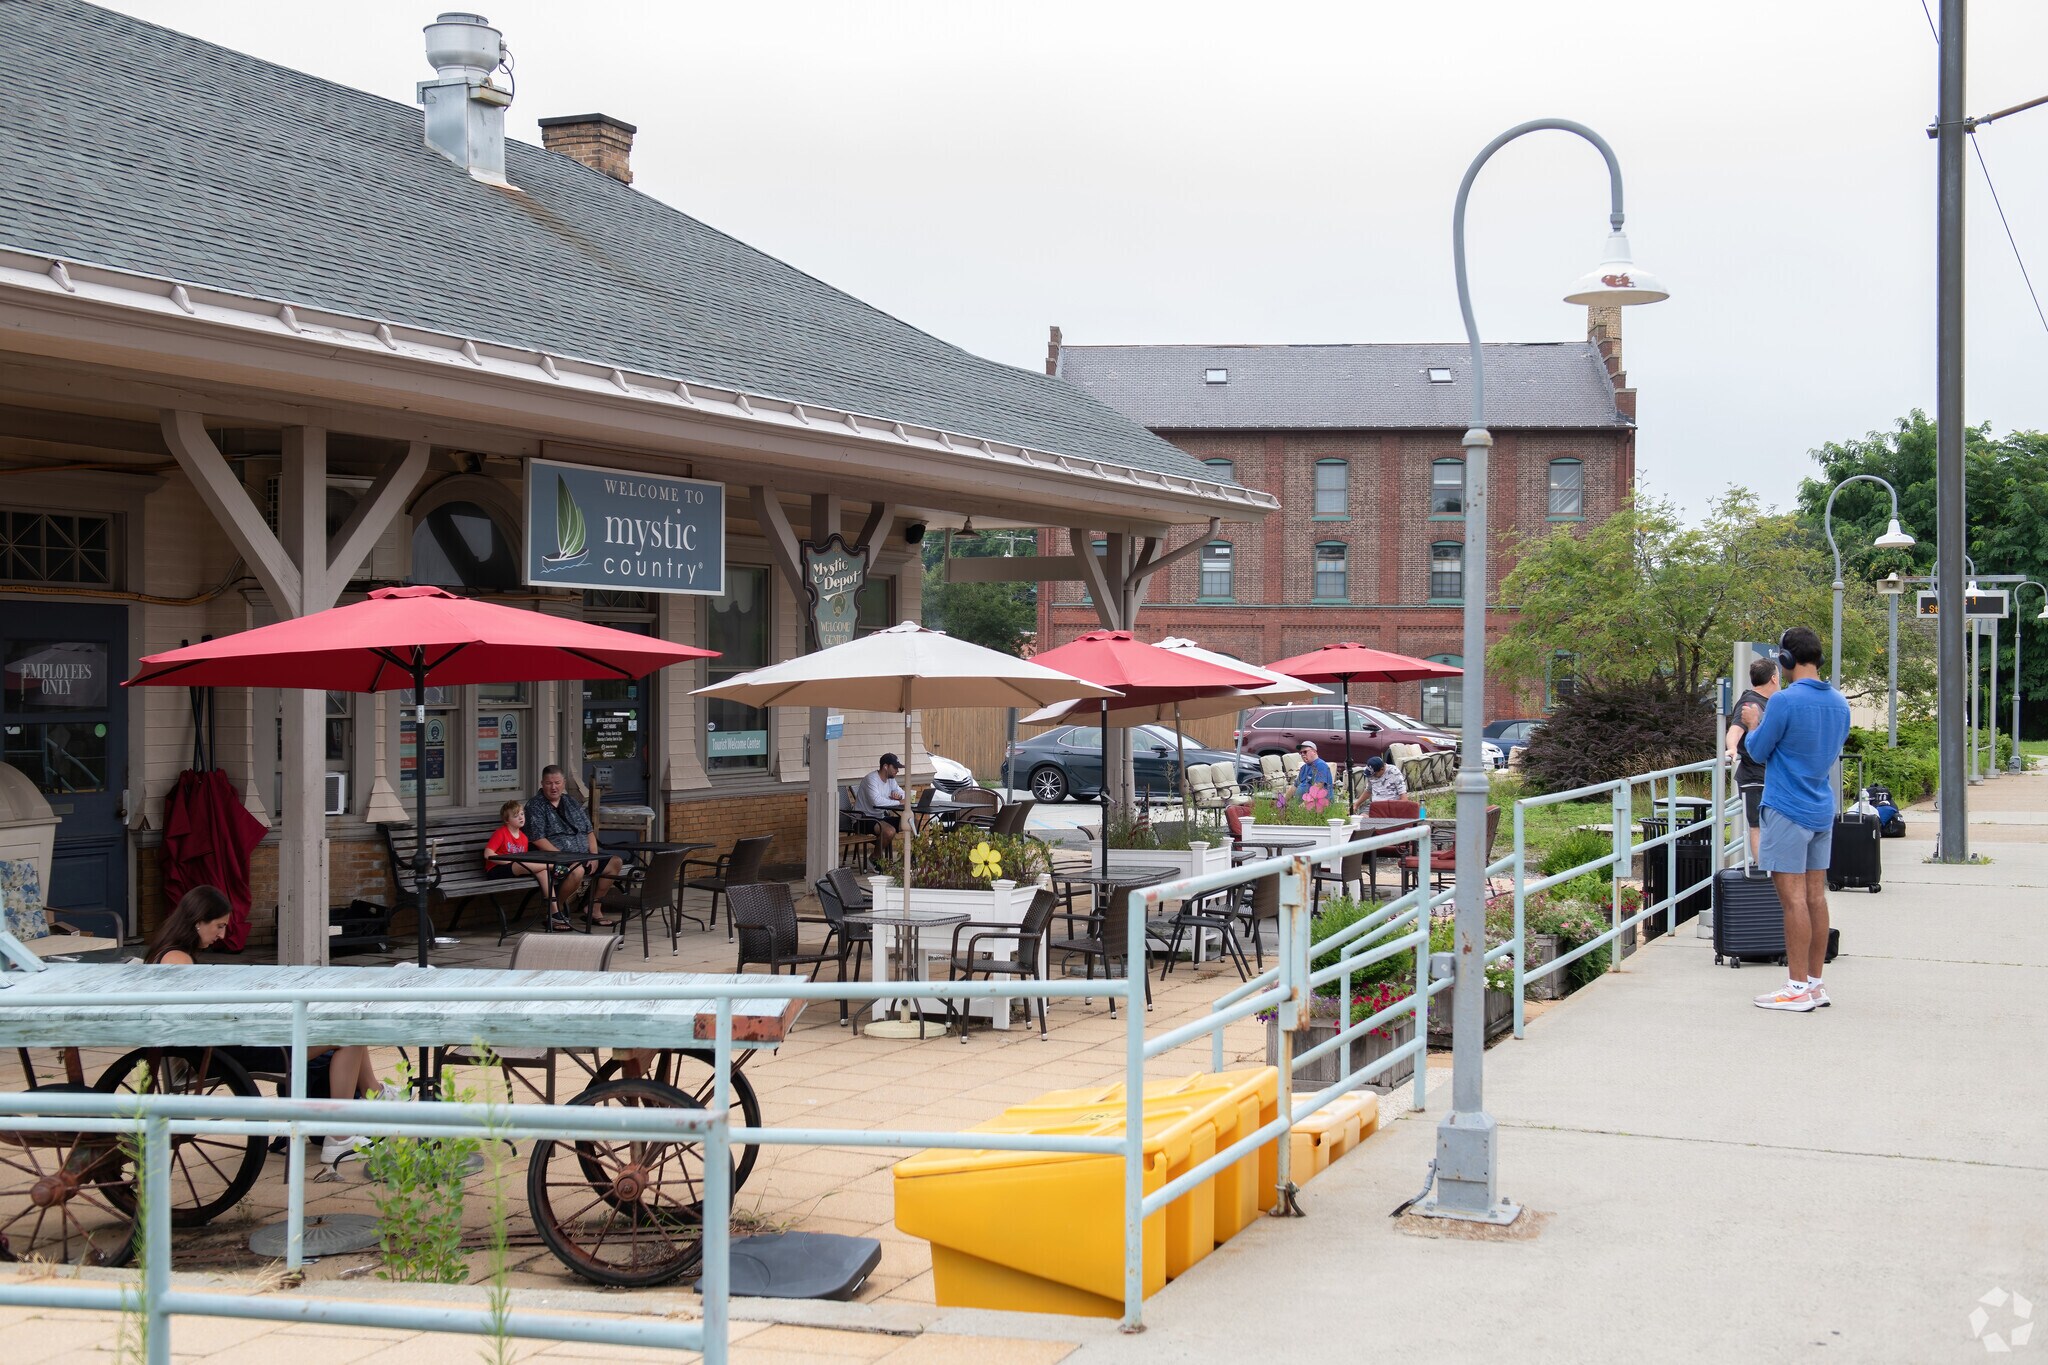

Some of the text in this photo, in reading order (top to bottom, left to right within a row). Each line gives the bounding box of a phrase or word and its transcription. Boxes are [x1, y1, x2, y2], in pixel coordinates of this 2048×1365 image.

[604, 479, 704, 505] WELCOME TO
[604, 508, 697, 556] mystic
[813, 557, 849, 584] Mystic
[824, 570, 862, 594] Depot
[821, 621, 851, 632] WELCOME
[22, 663, 92, 679] EMPLOYEES
[41, 678, 73, 695] ONLY
[712, 737, 760, 750] Tourist Welcome Center
